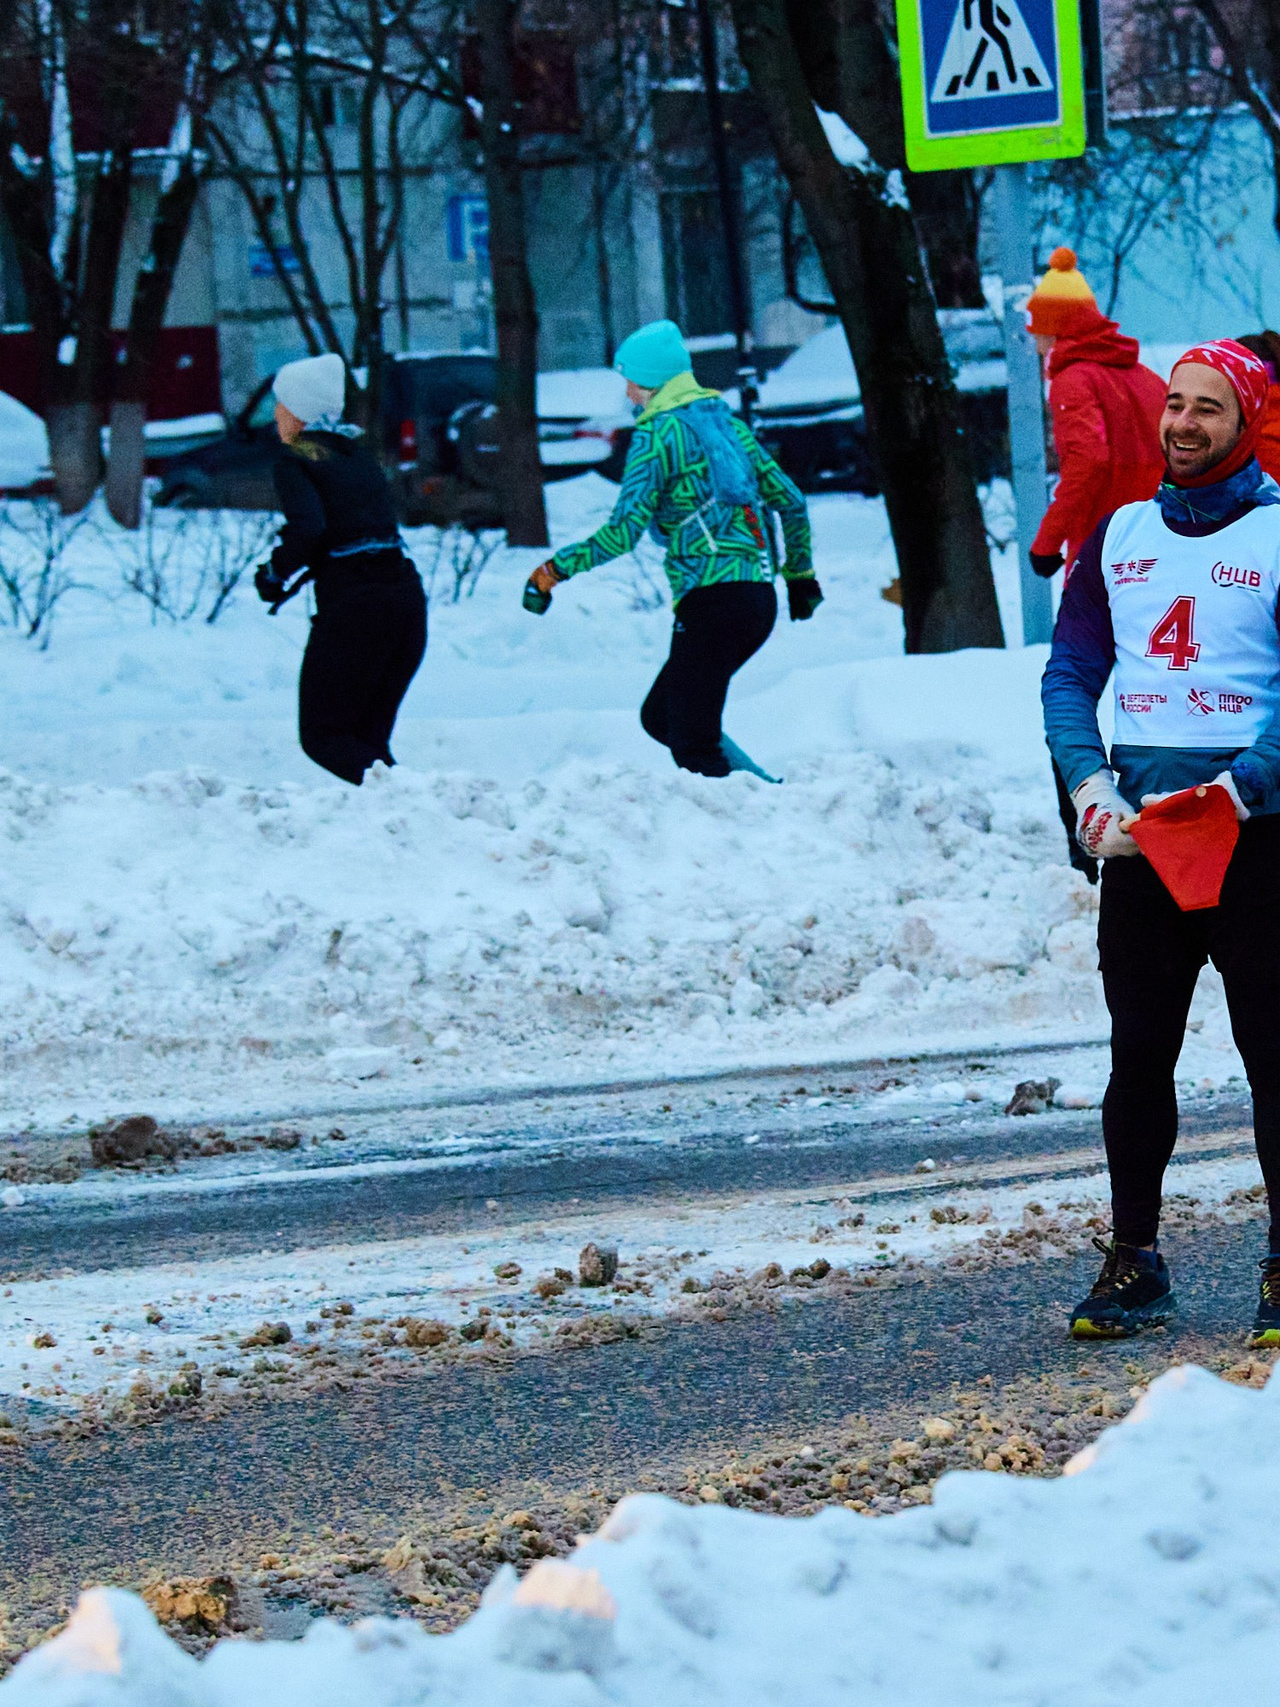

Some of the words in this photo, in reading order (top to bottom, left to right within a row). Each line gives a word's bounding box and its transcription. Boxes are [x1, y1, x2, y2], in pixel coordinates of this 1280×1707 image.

[1219, 565, 1261, 587] НЦВ
[1144, 595, 1201, 671] 4
[1219, 693, 1253, 705] ППОО
[1126, 703, 1151, 712] РОССИИ
[1219, 704, 1242, 714] НЦВ
